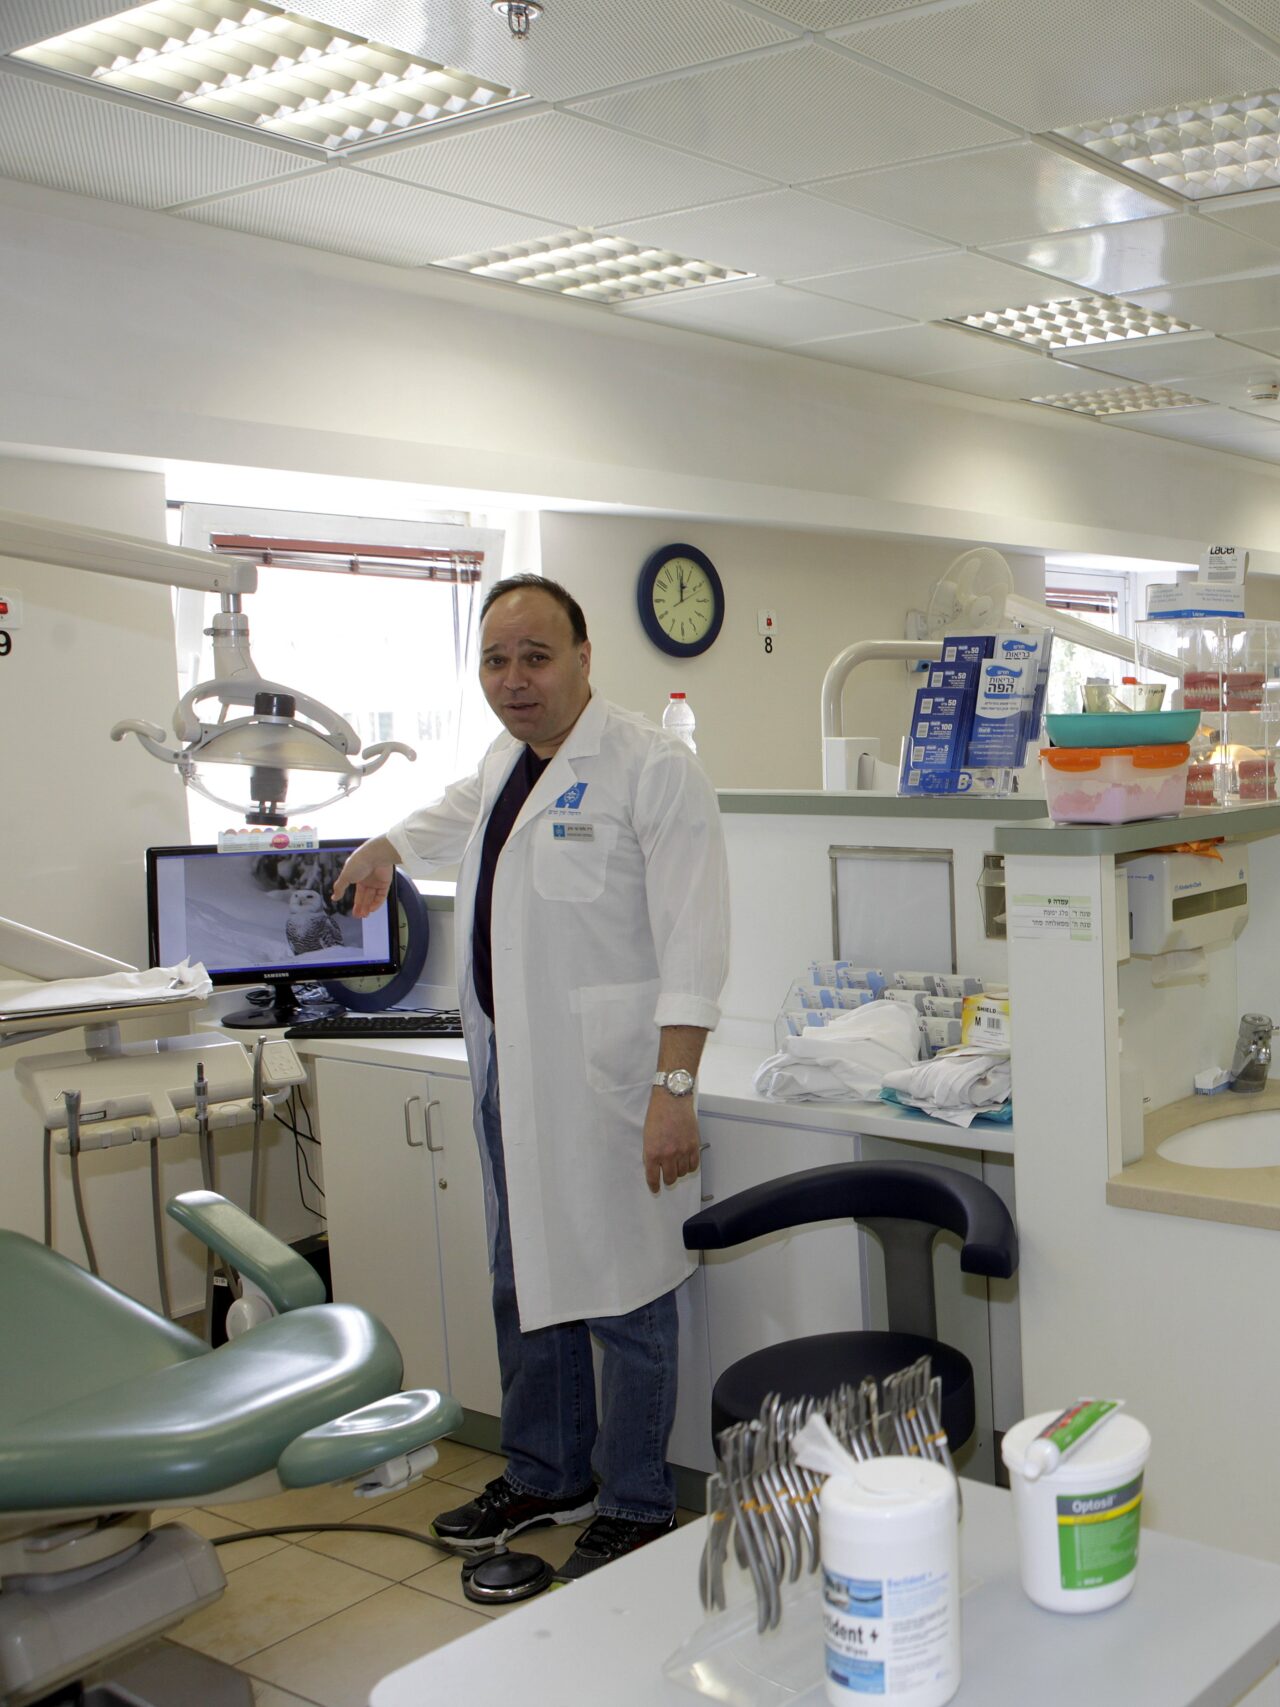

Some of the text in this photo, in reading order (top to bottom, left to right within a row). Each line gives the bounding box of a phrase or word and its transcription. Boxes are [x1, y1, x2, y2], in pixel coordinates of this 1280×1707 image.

[0, 630, 12, 656] 9
[765, 637, 773, 653] 8
[988, 683, 1014, 693] הפה
[975, 1016, 981, 1026] M
[1072, 1495, 1113, 1514] Optosil
